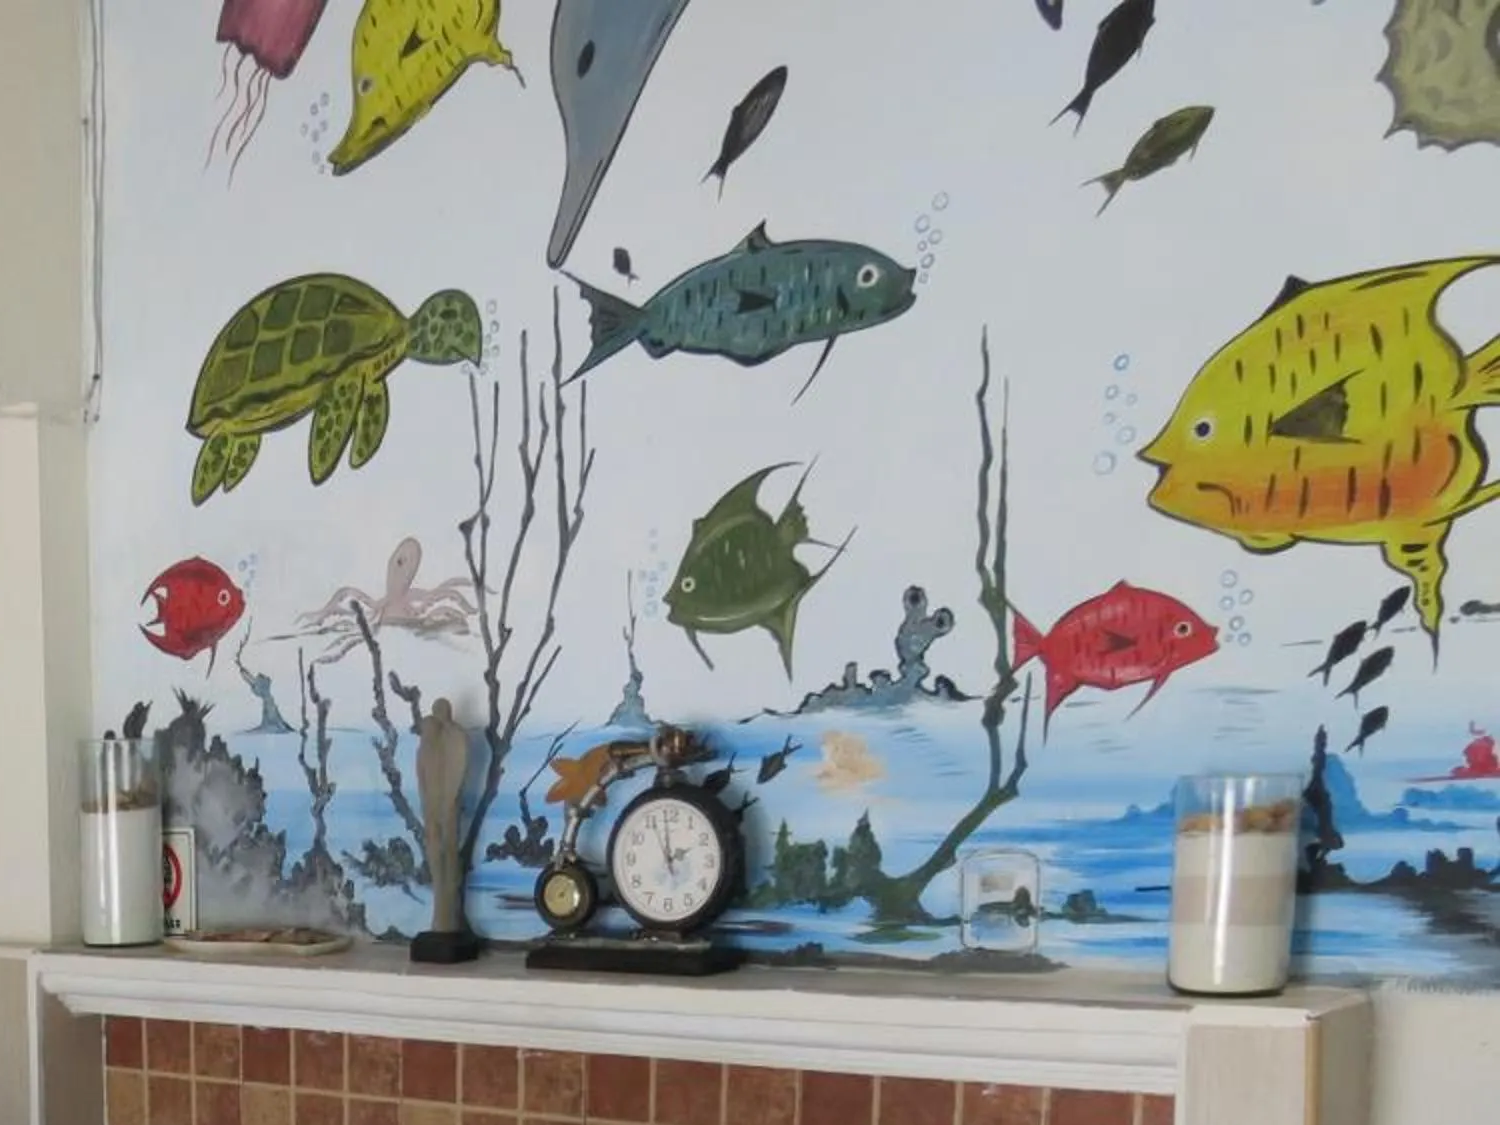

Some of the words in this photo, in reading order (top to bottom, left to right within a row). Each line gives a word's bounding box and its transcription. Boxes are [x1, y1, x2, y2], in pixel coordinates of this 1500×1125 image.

[644, 814, 658, 830] 11
[662, 808, 680, 824] 12
[687, 814, 696, 831] 1
[698, 832, 710, 848] 2
[625, 851, 637, 868] 9
[631, 874, 642, 889] 8
[642, 890, 655, 907] 7
[663, 897, 674, 913] 6
[683, 892, 694, 908] 5
